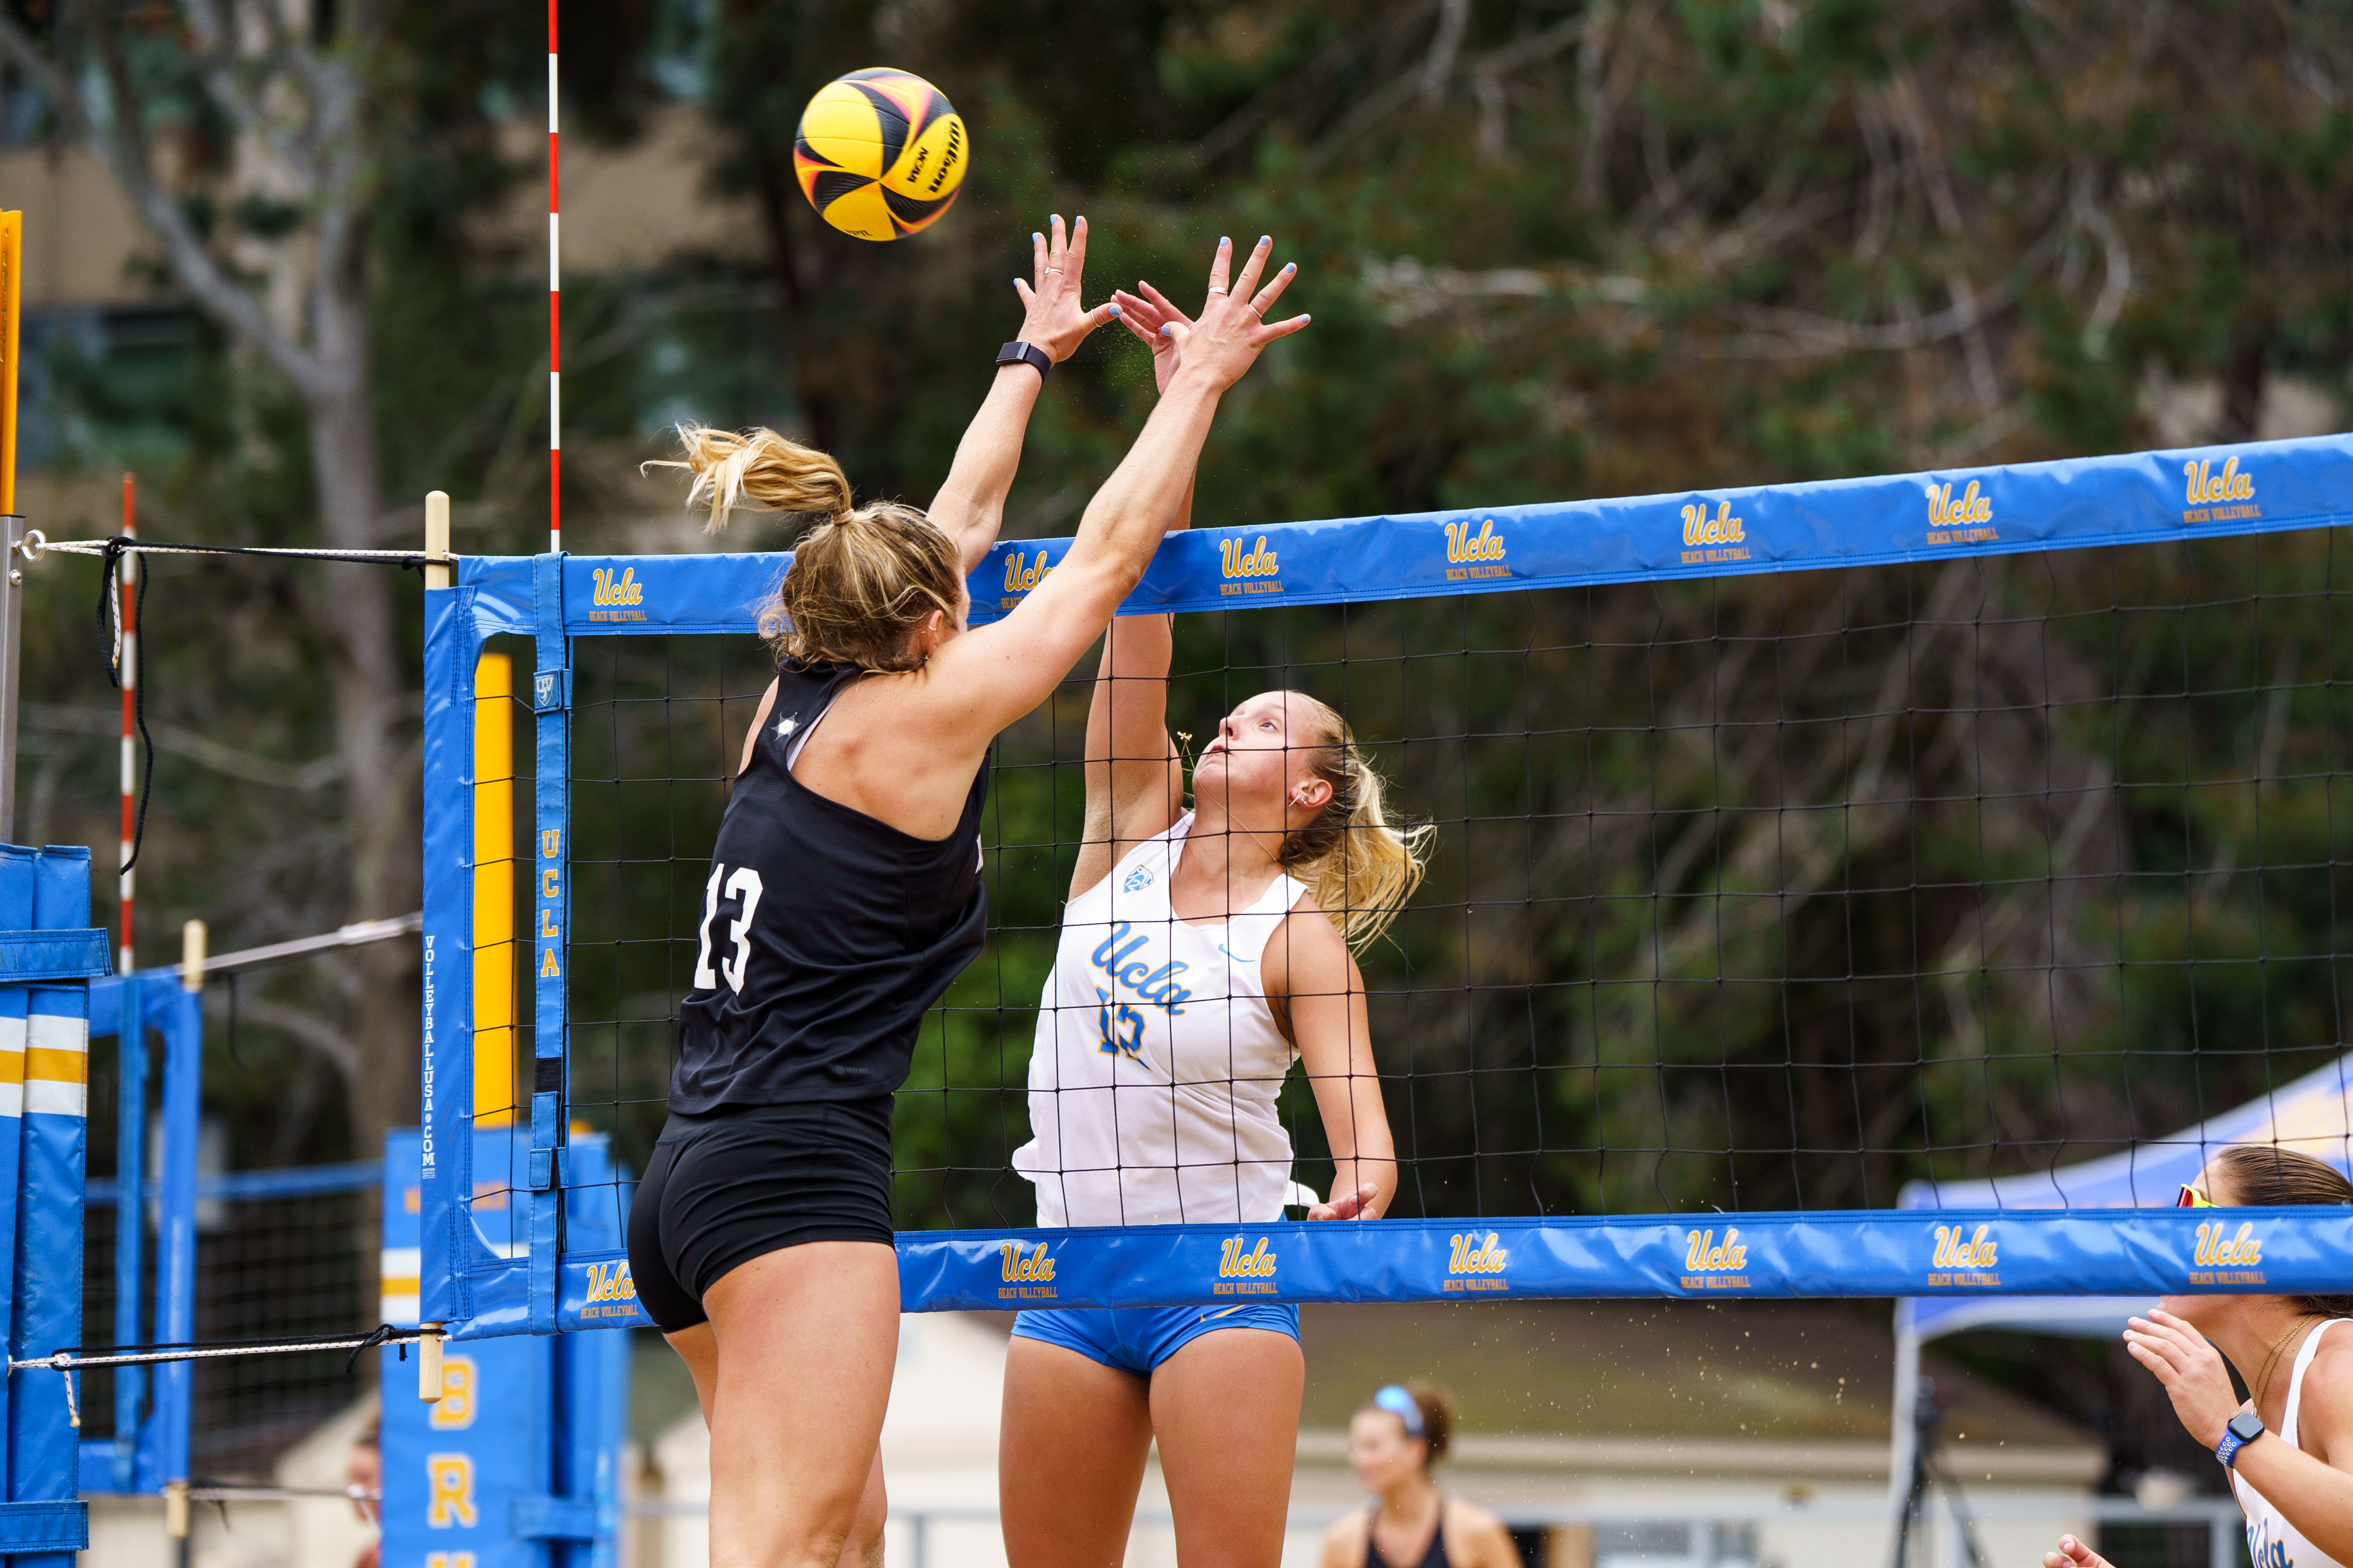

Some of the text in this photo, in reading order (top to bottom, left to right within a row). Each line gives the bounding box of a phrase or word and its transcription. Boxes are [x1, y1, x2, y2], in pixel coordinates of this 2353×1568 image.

[906, 146, 930, 184] NCAA
[929, 120, 960, 193] Wilson
[2184, 456, 2254, 505] Ucla
[1680, 501, 1746, 546] Ucla
[1926, 480, 1992, 527] Ucla
[2183, 505, 2262, 524] BEACH VOLLEYBALL
[1219, 535, 1279, 579] Ucla
[1444, 519, 1506, 563] Ucla
[1681, 548, 1751, 564] BEACH VOLLEYBALL
[1927, 528, 1999, 545] BEACH VOLLEYBALL
[593, 567, 643, 606] Ucla
[1220, 580, 1284, 595] BEACH VOLLEYBALL
[1446, 565, 1512, 580] BEACH VOLLEYBALL
[589, 610, 648, 622] BEACH VOLLEYBALL
[540, 829, 560, 977] UCLA
[694, 863, 763, 997] 13
[1092, 919, 1192, 1016] Ucla
[1000, 1241, 1056, 1282] Ucla
[1220, 1237, 1277, 1278] Ucla
[1449, 1232, 1507, 1274] Ucla
[1685, 1228, 1747, 1272] Ucla
[1933, 1224, 1999, 1268] Ucla
[2193, 1222, 2262, 1267] Ucla
[587, 1262, 636, 1303] Ucla
[997, 1286, 1058, 1299] BEACH VOLLEYBALL
[1213, 1282, 1278, 1295] BEACH VOLLEYBALL
[1443, 1278, 1509, 1292] BEACH VOLLEYBALL
[1681, 1275, 1751, 1289] BEACH VOLLEYBALL
[1928, 1273, 2001, 1286] BEACH VOLLEYBALL
[2189, 1271, 2266, 1285] BEACH VOLLEYBALL
[580, 1304, 638, 1319] BEACH VOLLEYBALL
[426, 1354, 478, 1568] BR
